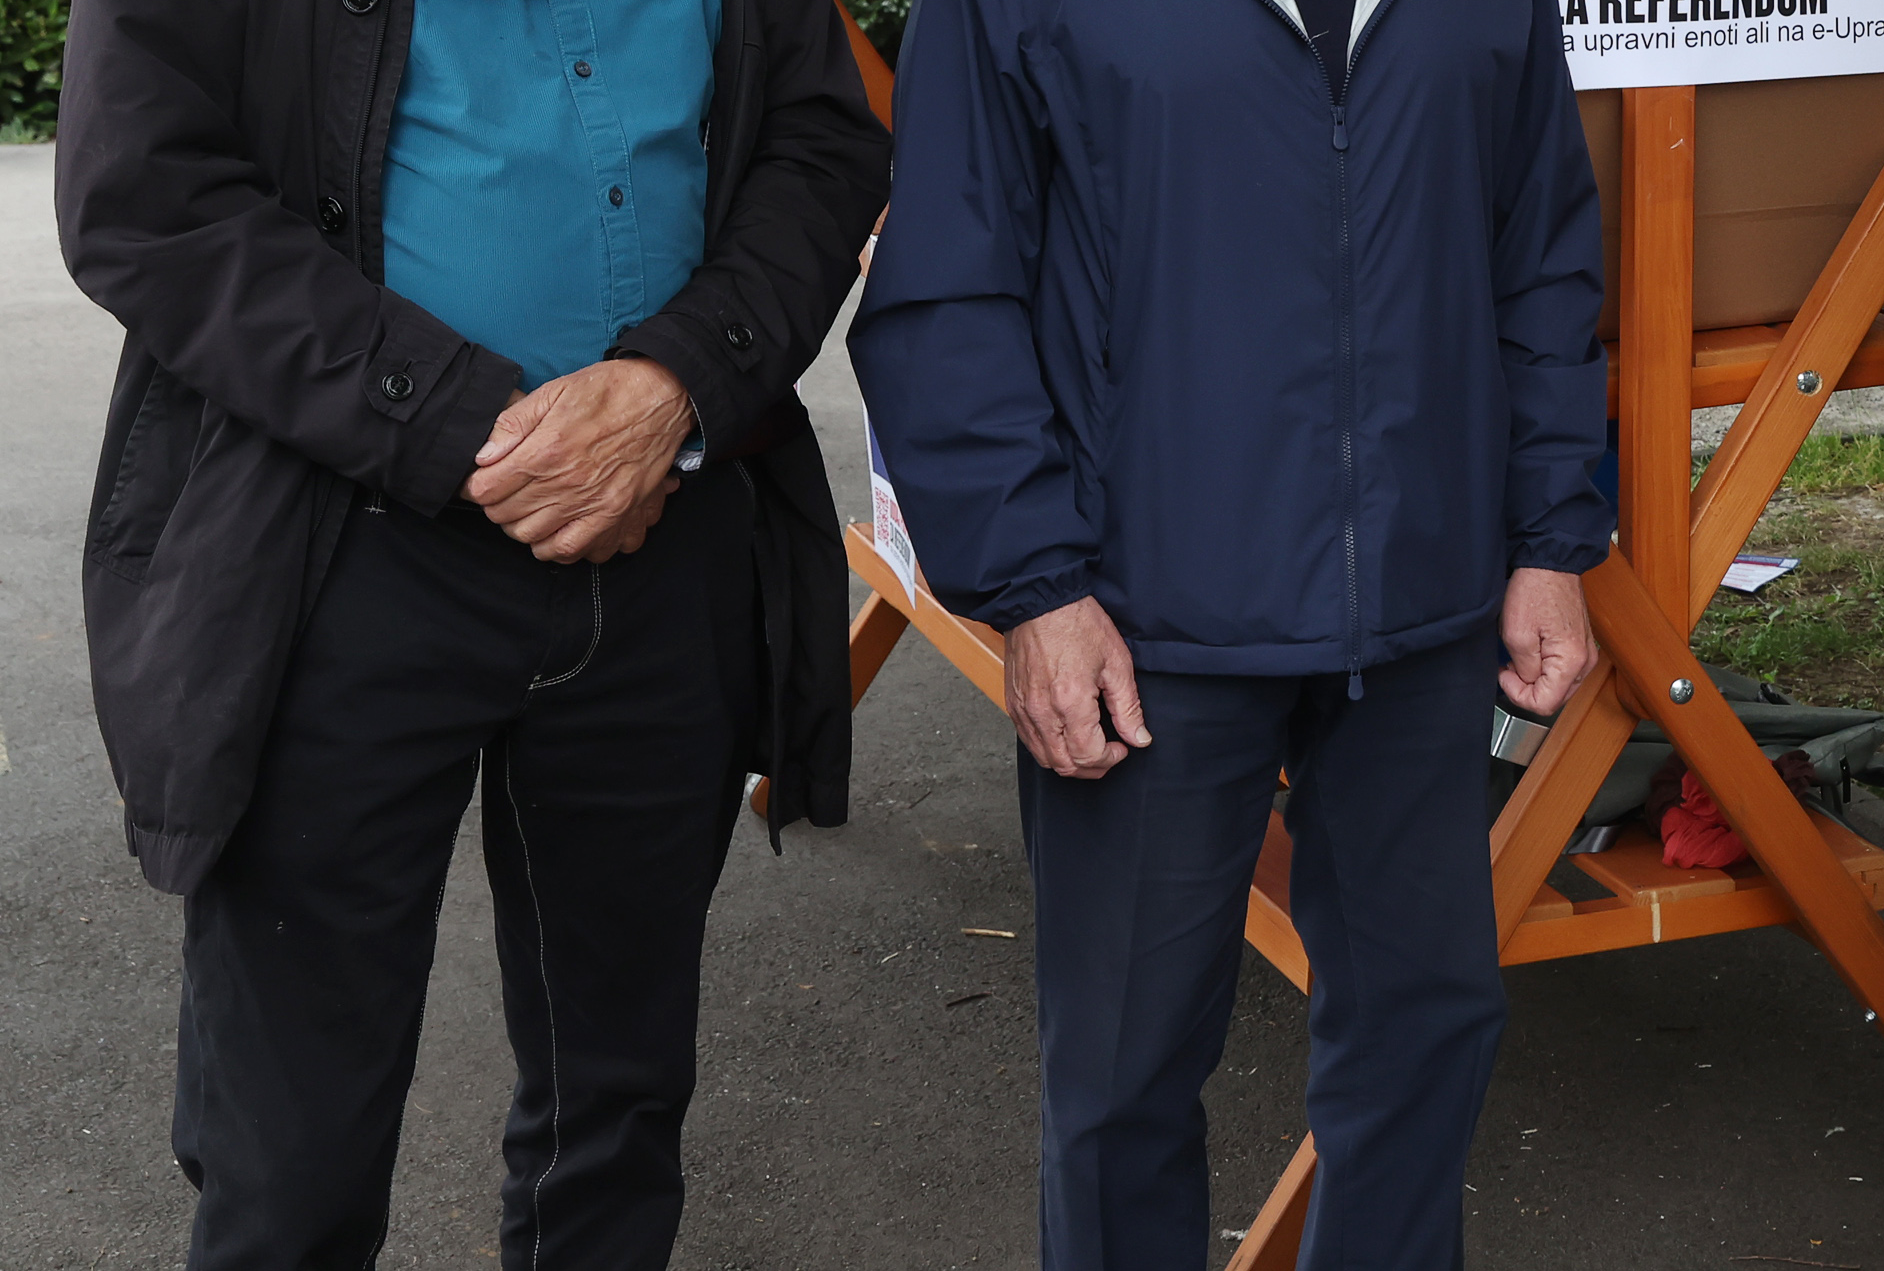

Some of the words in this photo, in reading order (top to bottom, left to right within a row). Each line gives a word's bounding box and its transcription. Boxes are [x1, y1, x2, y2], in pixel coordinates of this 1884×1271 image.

[1584, 26, 1675, 57] upravni
[1684, 23, 1738, 49] enoti
[1745, 21, 1769, 45] ali
[1777, 24, 1804, 42] na
